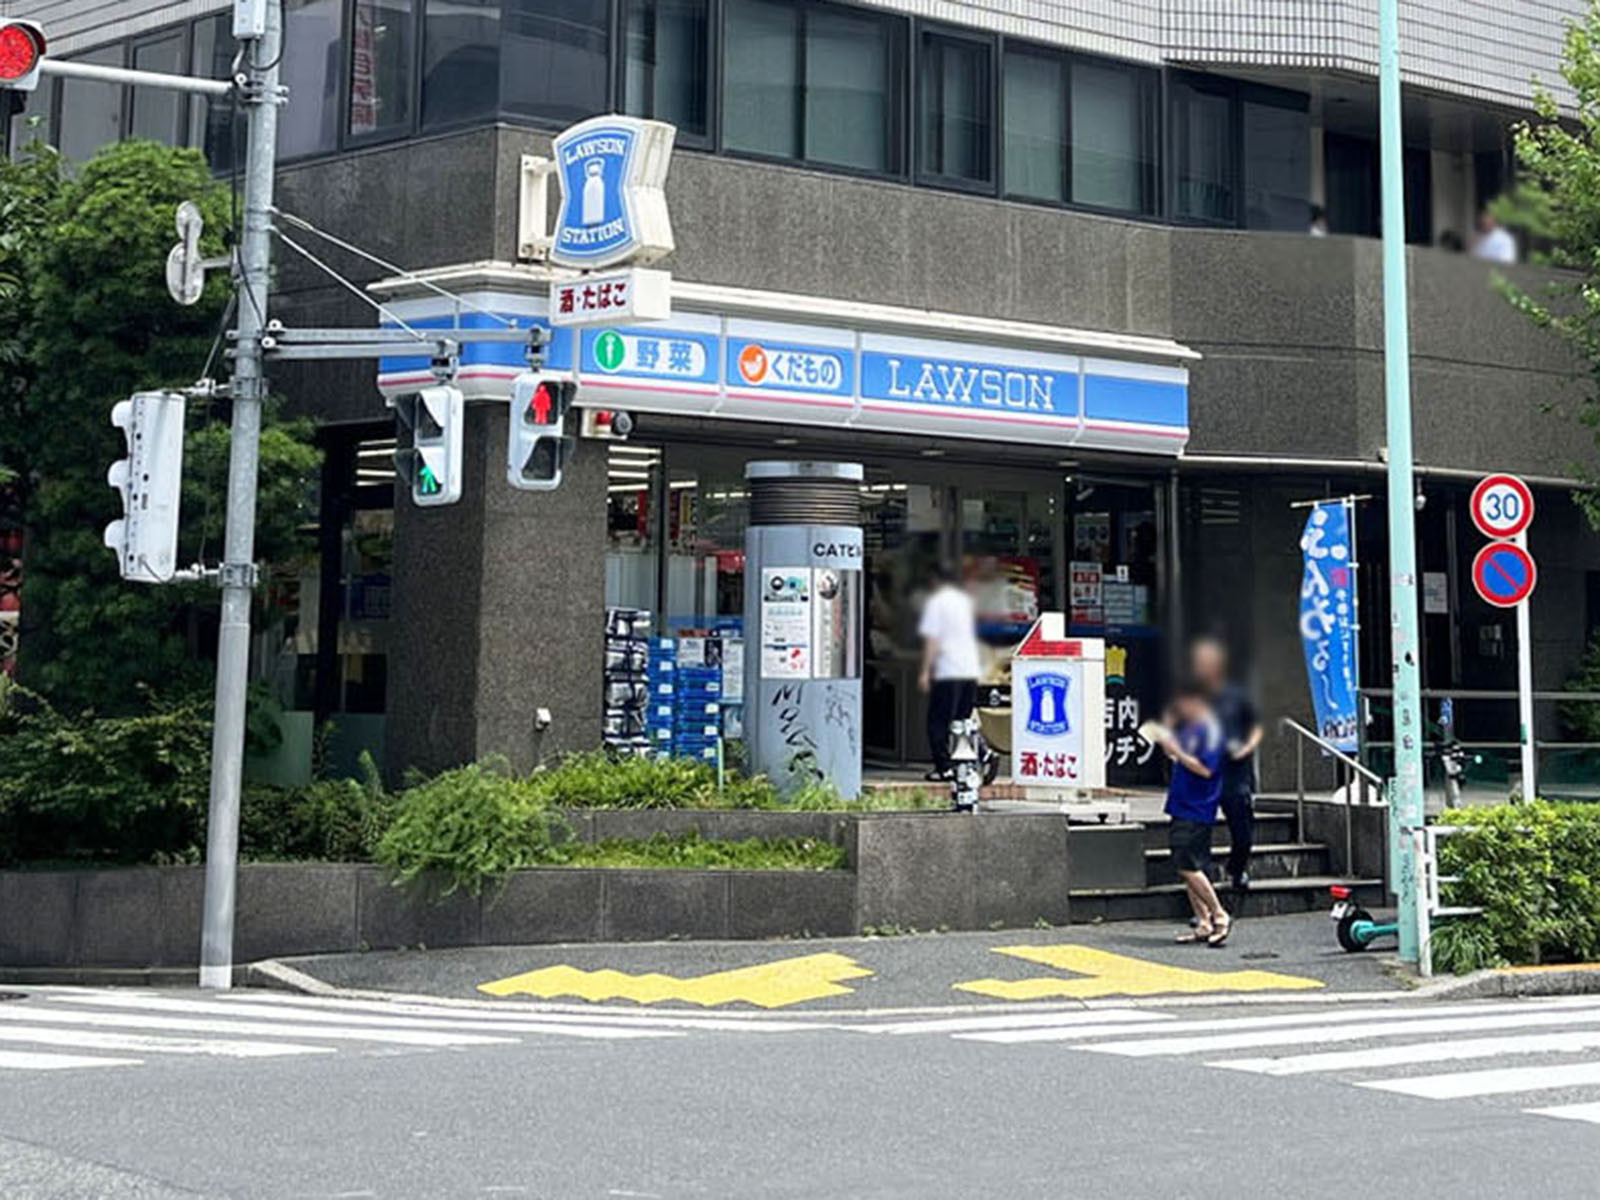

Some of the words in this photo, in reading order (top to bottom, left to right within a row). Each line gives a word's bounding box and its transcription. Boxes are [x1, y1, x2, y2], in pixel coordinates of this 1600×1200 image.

[565, 137, 625, 166] LAWSON
[562, 218, 625, 244] STATION
[560, 283, 626, 313] 酒・たばこ
[637, 340, 692, 371] 野菜
[771, 353, 836, 385] くだもの
[888, 360, 1054, 411] LAWSON
[1486, 493, 1519, 520] 30
[1020, 751, 1077, 778] 酒・たばこ
